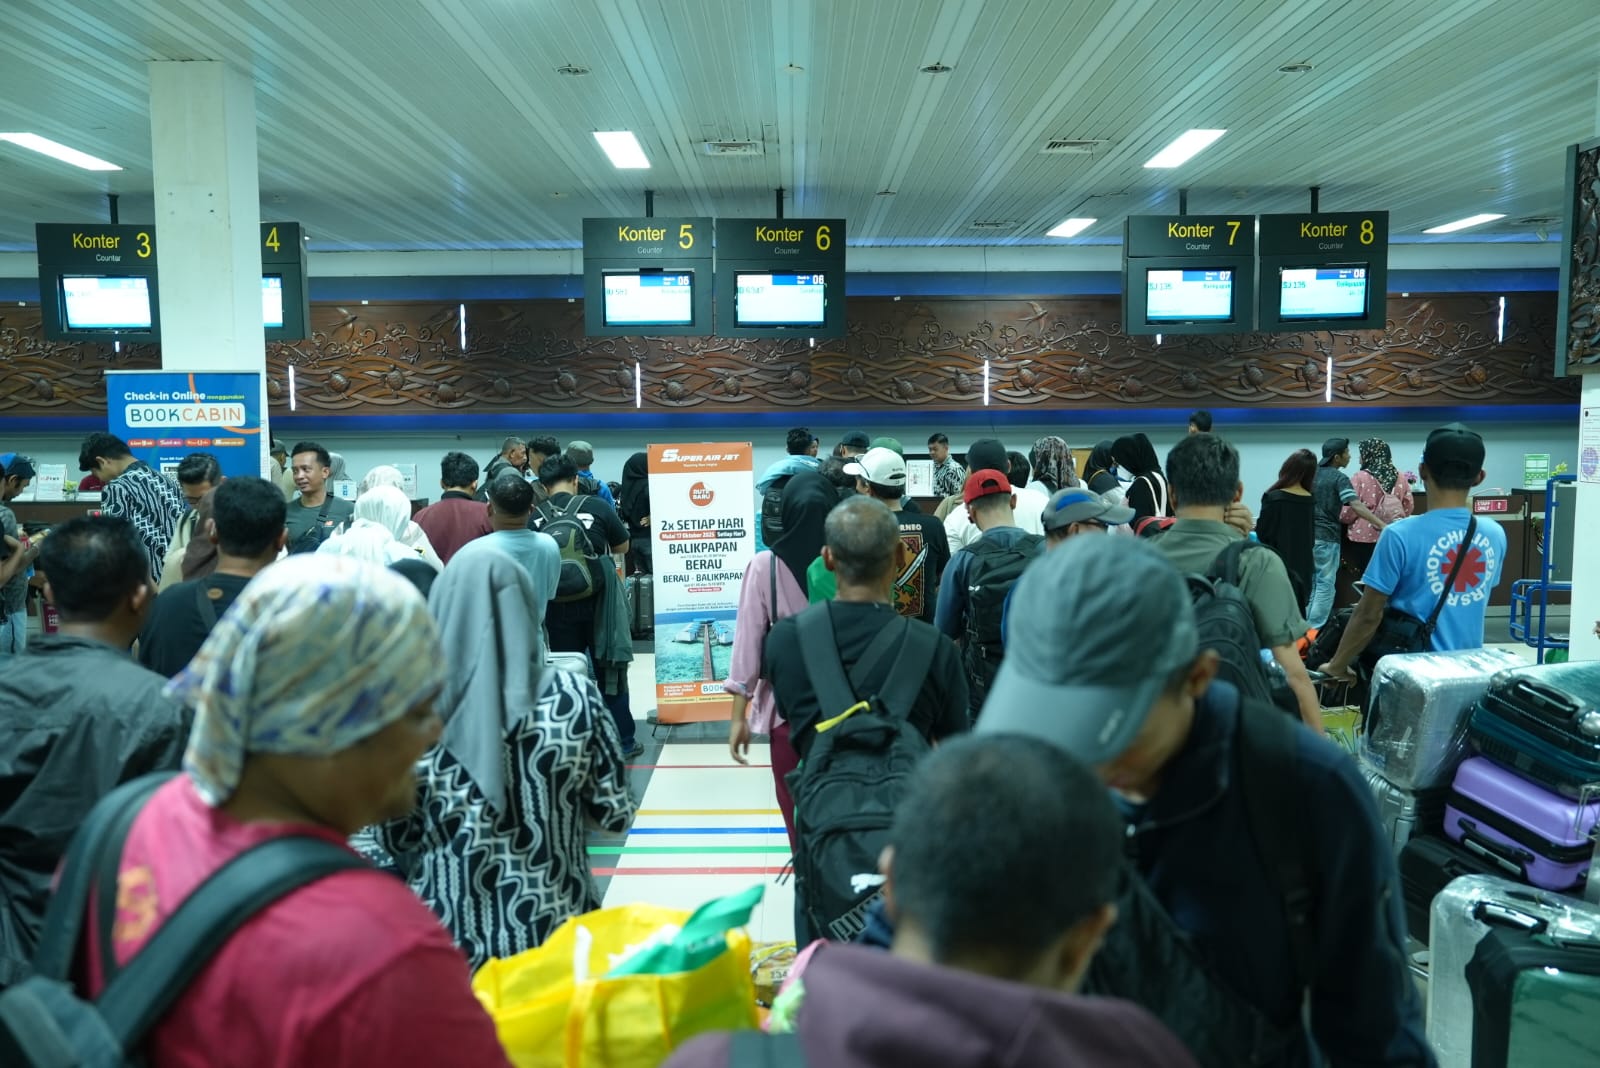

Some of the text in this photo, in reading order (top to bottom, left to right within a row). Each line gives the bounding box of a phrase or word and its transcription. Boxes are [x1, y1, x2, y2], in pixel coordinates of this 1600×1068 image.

[619, 224, 694, 249] Konter 5
[756, 225, 831, 251] Konter 6
[1168, 221, 1241, 246] Konter 7
[1301, 219, 1374, 245] Konter 8
[73, 232, 151, 258] Konter 3
[266, 227, 280, 252] 4
[1318, 242, 1343, 250] Counter
[637, 246, 663, 254] Counter
[774, 247, 800, 255] Counter
[96, 254, 121, 262] Counter
[124, 391, 206, 401] Check-in Online
[131, 407, 241, 422] BOOKCABIN
[722, 453, 740, 461] JET
[661, 517, 744, 531] 2x SETIAP HARI
[669, 541, 737, 554] BALIKPAPAN
[685, 559, 722, 570] BERAU
[663, 575, 690, 583] BERAU
[696, 572, 744, 582] BALIKPAPAN
